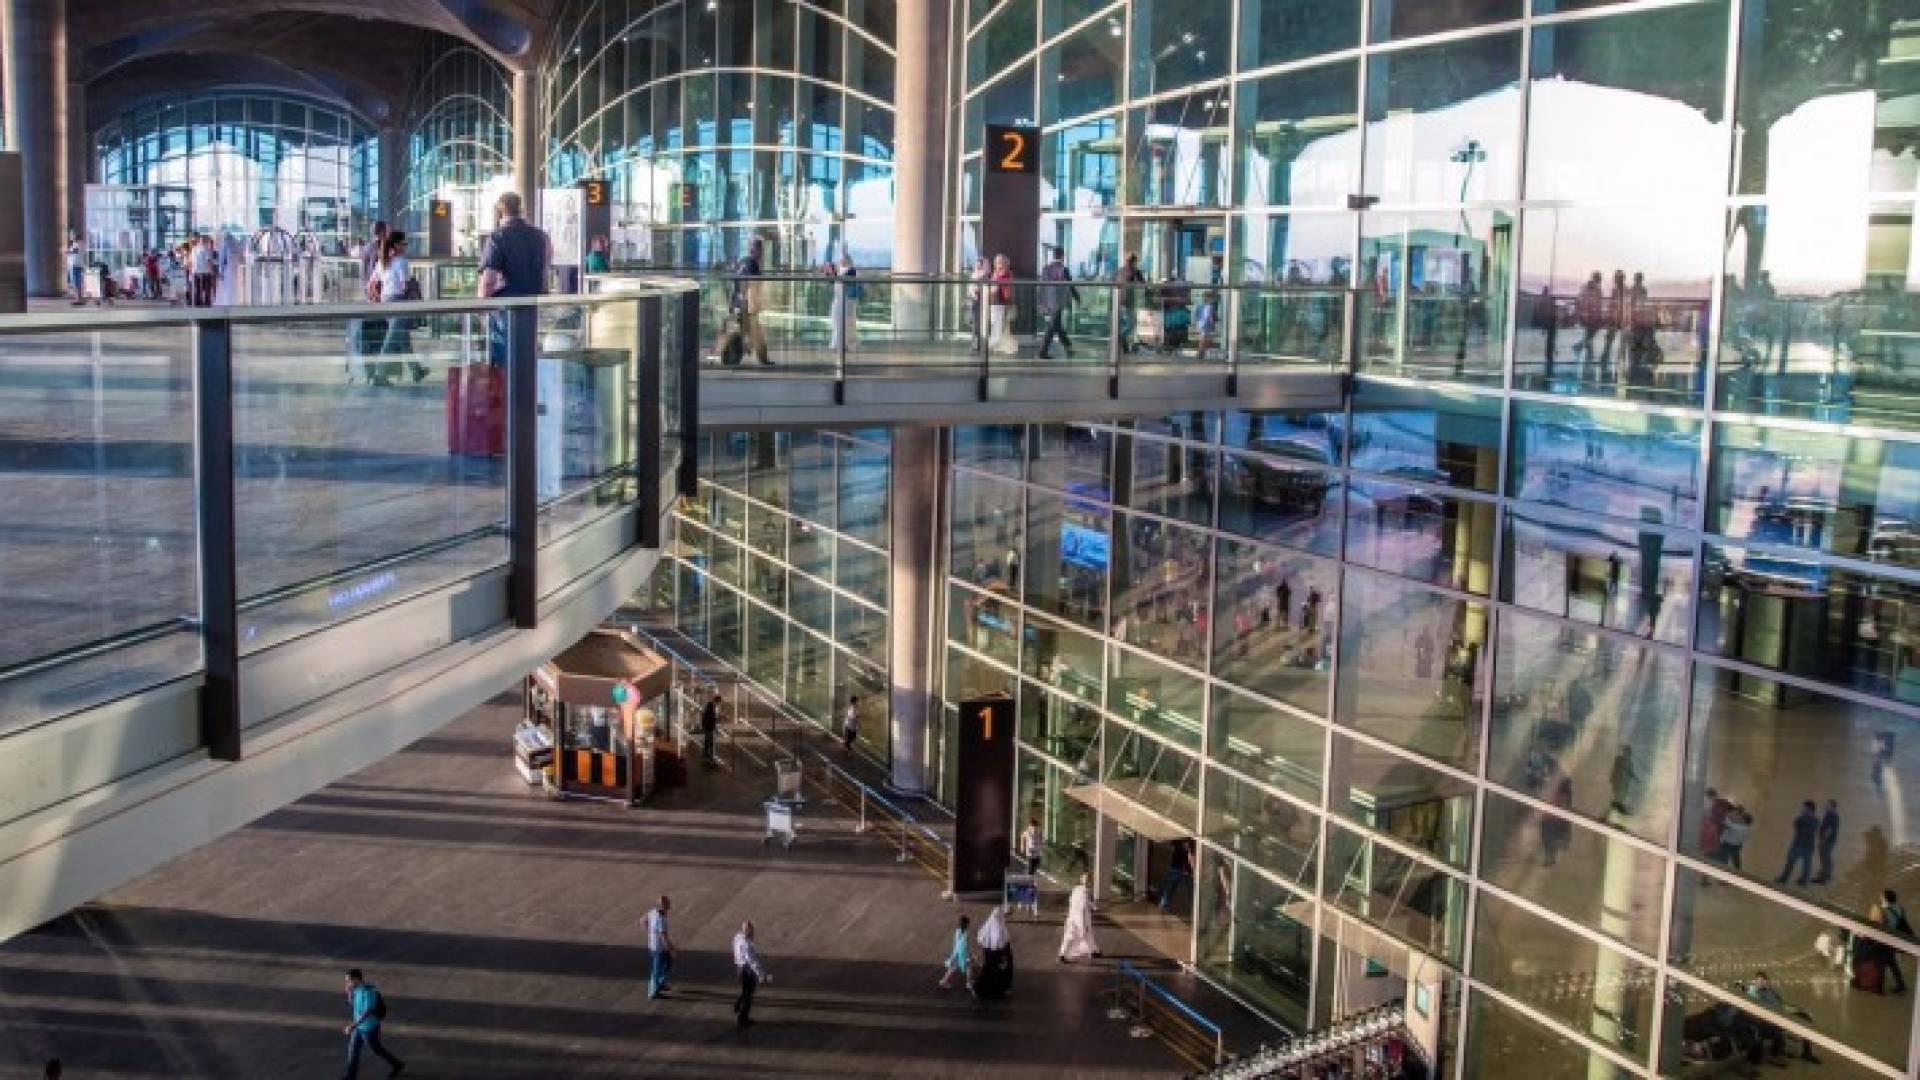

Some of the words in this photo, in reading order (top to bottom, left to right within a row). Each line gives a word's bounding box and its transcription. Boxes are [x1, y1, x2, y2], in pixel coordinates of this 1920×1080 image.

[1002, 131, 1024, 169] 2
[588, 183, 601, 204] 3
[978, 706, 992, 740] 1
